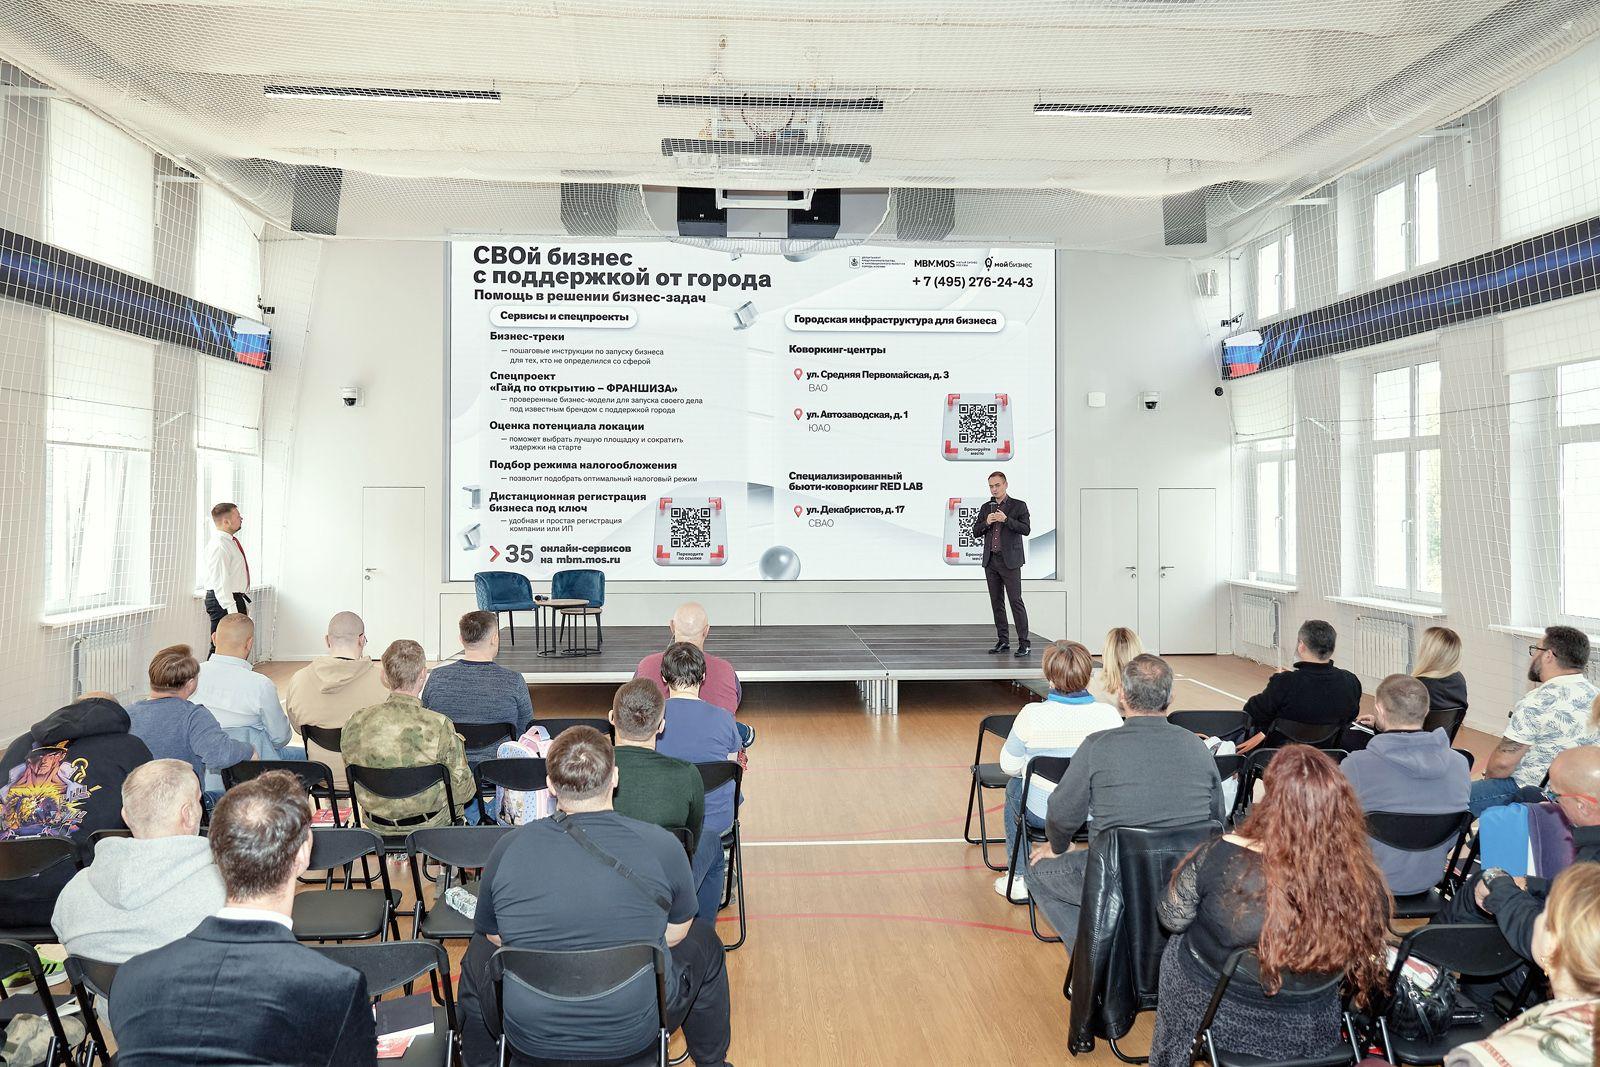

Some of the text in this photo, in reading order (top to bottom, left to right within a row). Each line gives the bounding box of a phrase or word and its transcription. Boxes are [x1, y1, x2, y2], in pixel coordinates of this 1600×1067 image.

[473, 245, 633, 266] СВОй бизнес
[473, 267, 772, 291] с поддержкой от города
[923, 276, 931, 287] 7
[934, 276, 966, 289] (495)
[968, 276, 1033, 288] 276-24-43
[474, 289, 706, 304] Помощь в решении бизнес-задач
[500, 311, 548, 322] Сервисы
[558, 314, 629, 323] спецпроекты
[794, 314, 997, 326] Городская инфраструктура для бизнеса
[490, 331, 564, 343] Бизнес-треки
[789, 345, 886, 356] Коворкинг-центры
[622, 358, 651, 366] сферой
[490, 371, 556, 382] Спецпроект
[806, 372, 820, 380] ул.
[820, 370, 861, 380] Средняя
[862, 370, 932, 380] Первомайская,
[943, 371, 949, 379] 3
[490, 383, 521, 393] «Гайд
[538, 385, 595, 394] открытию
[606, 383, 678, 393] ФРАНШИЗА»
[808, 383, 828, 392] ВАО
[559, 396, 615, 404] бизнес-модели
[565, 406, 598, 414] брендом
[605, 406, 649, 414] поддержкой
[806, 410, 908, 420] ул. Автозаводская, д. 1
[489, 421, 644, 432] Оценка потенциала локации
[808, 423, 831, 432] ЮАО
[542, 435, 573, 444] выбрать
[490, 460, 677, 471] Подбор режима налогообложения
[544, 475, 582, 483] подобрать
[789, 471, 902, 482] Специализированный
[789, 482, 923, 493] бьюти-коворкинг RED LAB
[489, 491, 646, 503] Дистанционная регистрация
[489, 503, 533, 512] бизнеса
[536, 505, 556, 514] под
[806, 505, 905, 516] ул. Декабристов, д. 17
[509, 517, 538, 525] удобная
[808, 518, 834, 528] СВАО
[505, 544, 534, 563] 35
[540, 544, 632, 554] онлайн-сервисов
[556, 555, 620, 564] mbm.mos.ru
